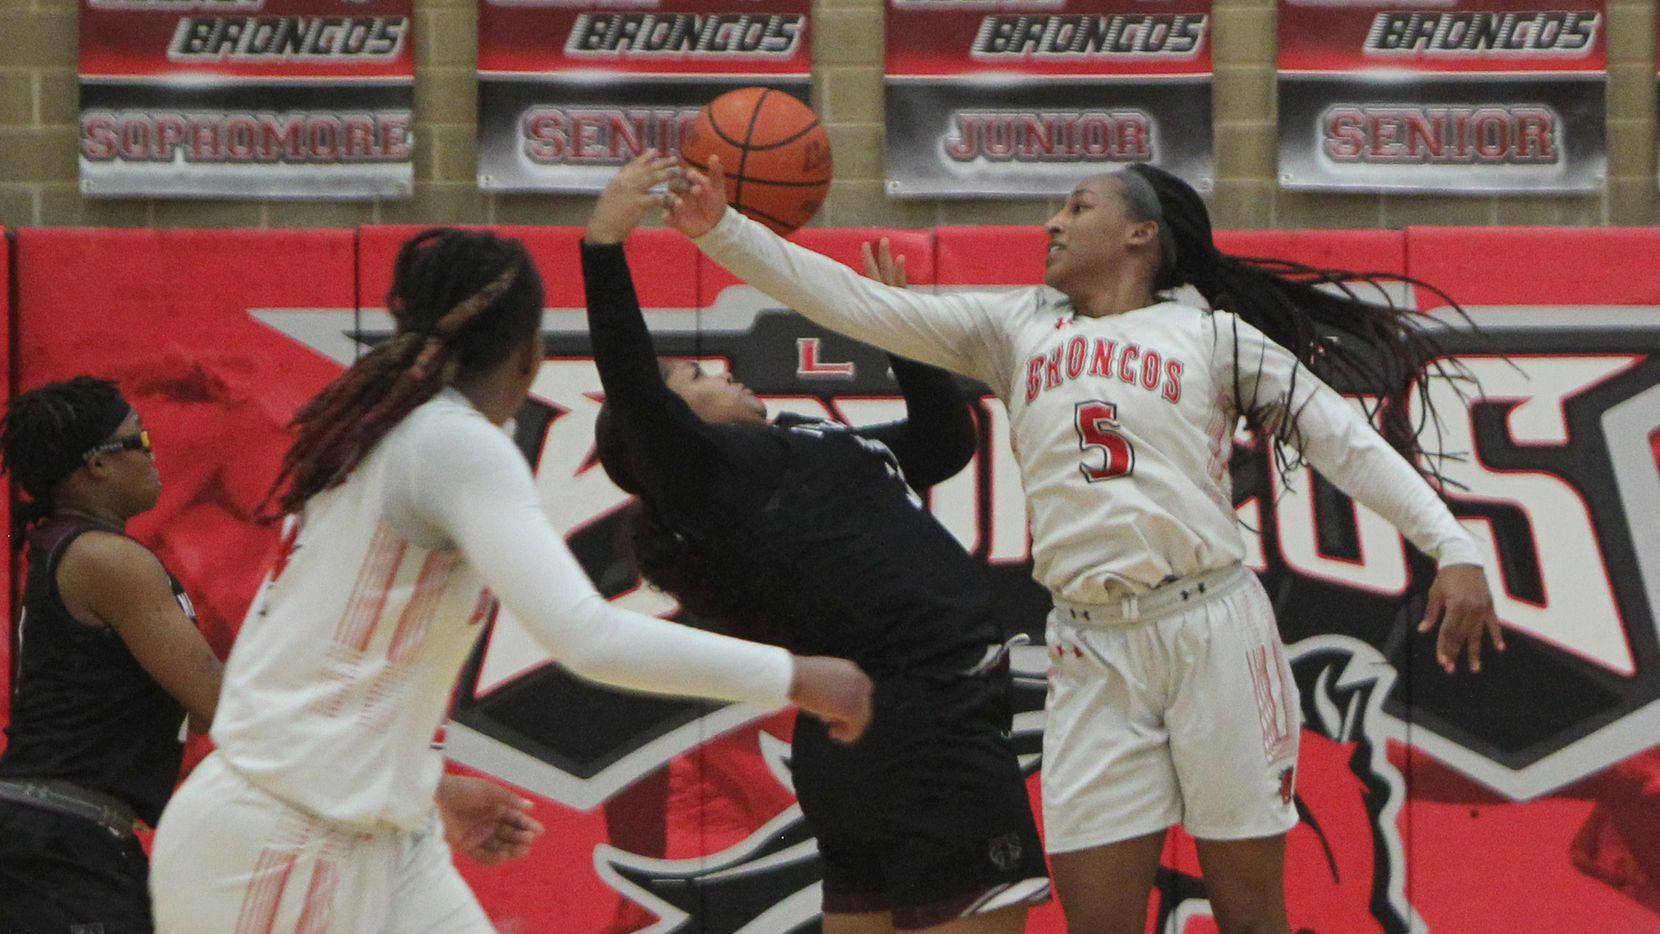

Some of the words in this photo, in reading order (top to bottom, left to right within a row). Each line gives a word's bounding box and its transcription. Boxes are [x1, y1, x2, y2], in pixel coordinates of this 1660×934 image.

[168, 16, 409, 59] BRONCOS
[565, 13, 806, 57] BRONCOS
[971, 14, 1208, 58] BRONCOS
[1363, 11, 1600, 54] BRONCOS
[80, 111, 413, 163] SOPHOMORE
[522, 104, 702, 166] SENI
[945, 110, 1154, 163] JUNIOR
[1322, 105, 1561, 165] SENIOR
[1074, 399, 1135, 484] 5
